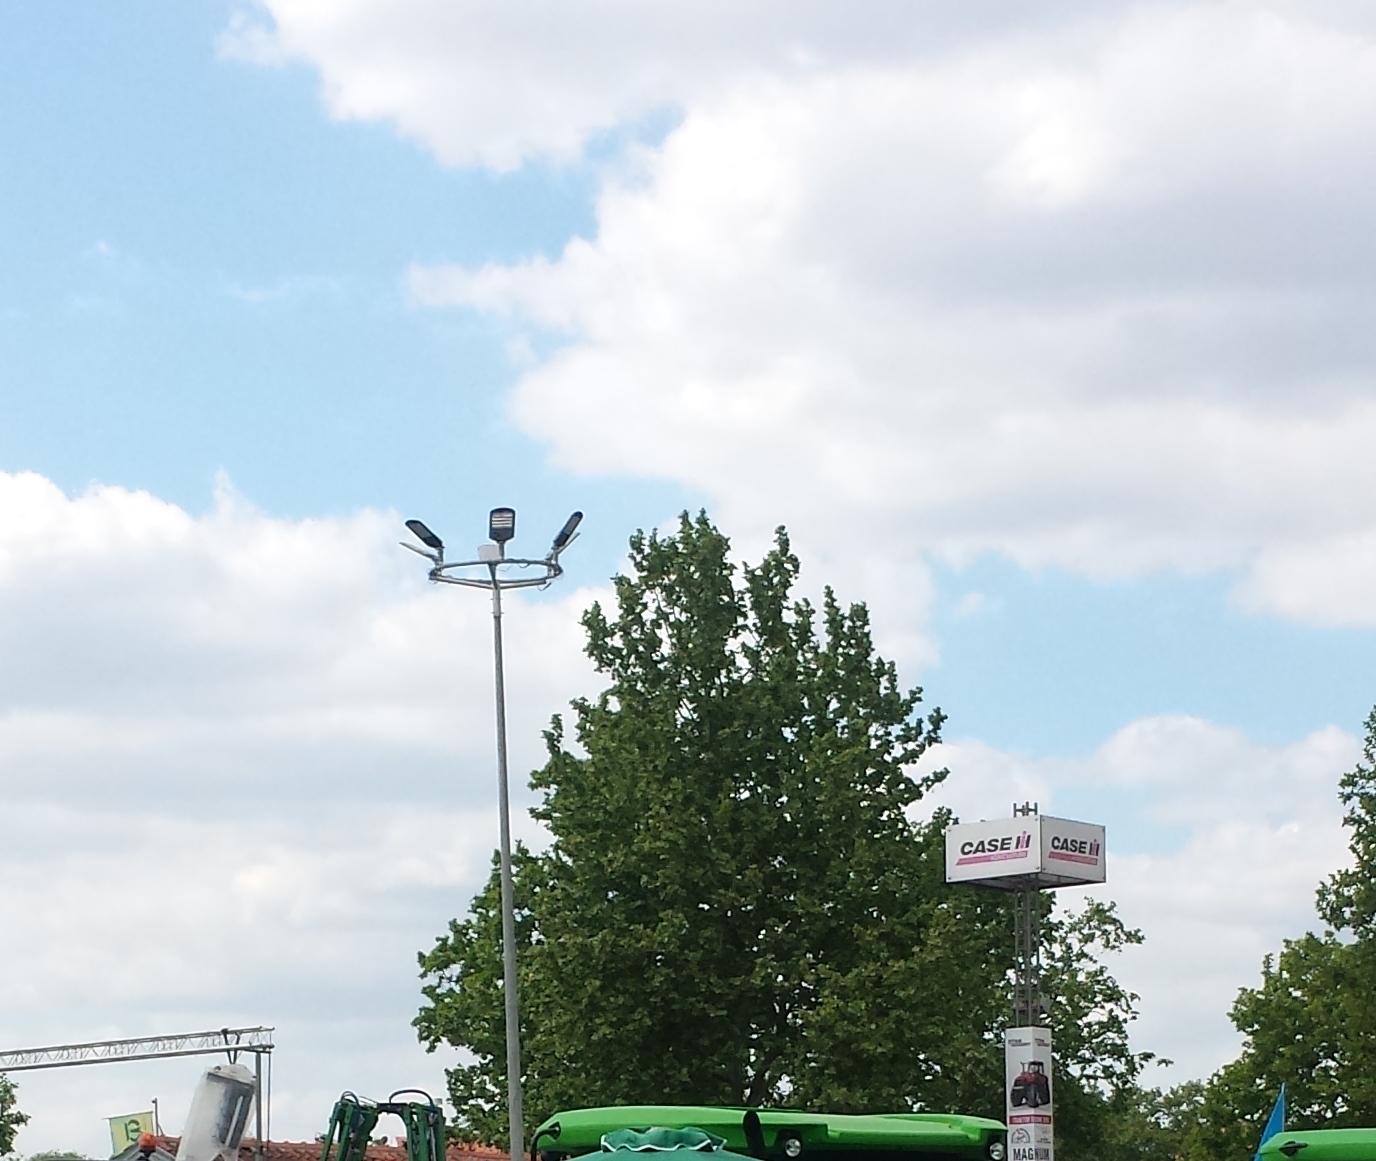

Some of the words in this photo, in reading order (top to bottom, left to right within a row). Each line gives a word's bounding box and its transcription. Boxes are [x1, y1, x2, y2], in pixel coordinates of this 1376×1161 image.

[960, 837, 1013, 856] CASE
[1051, 836, 1088, 855] CASE
[1013, 1148, 1050, 1161] MAGNUM
